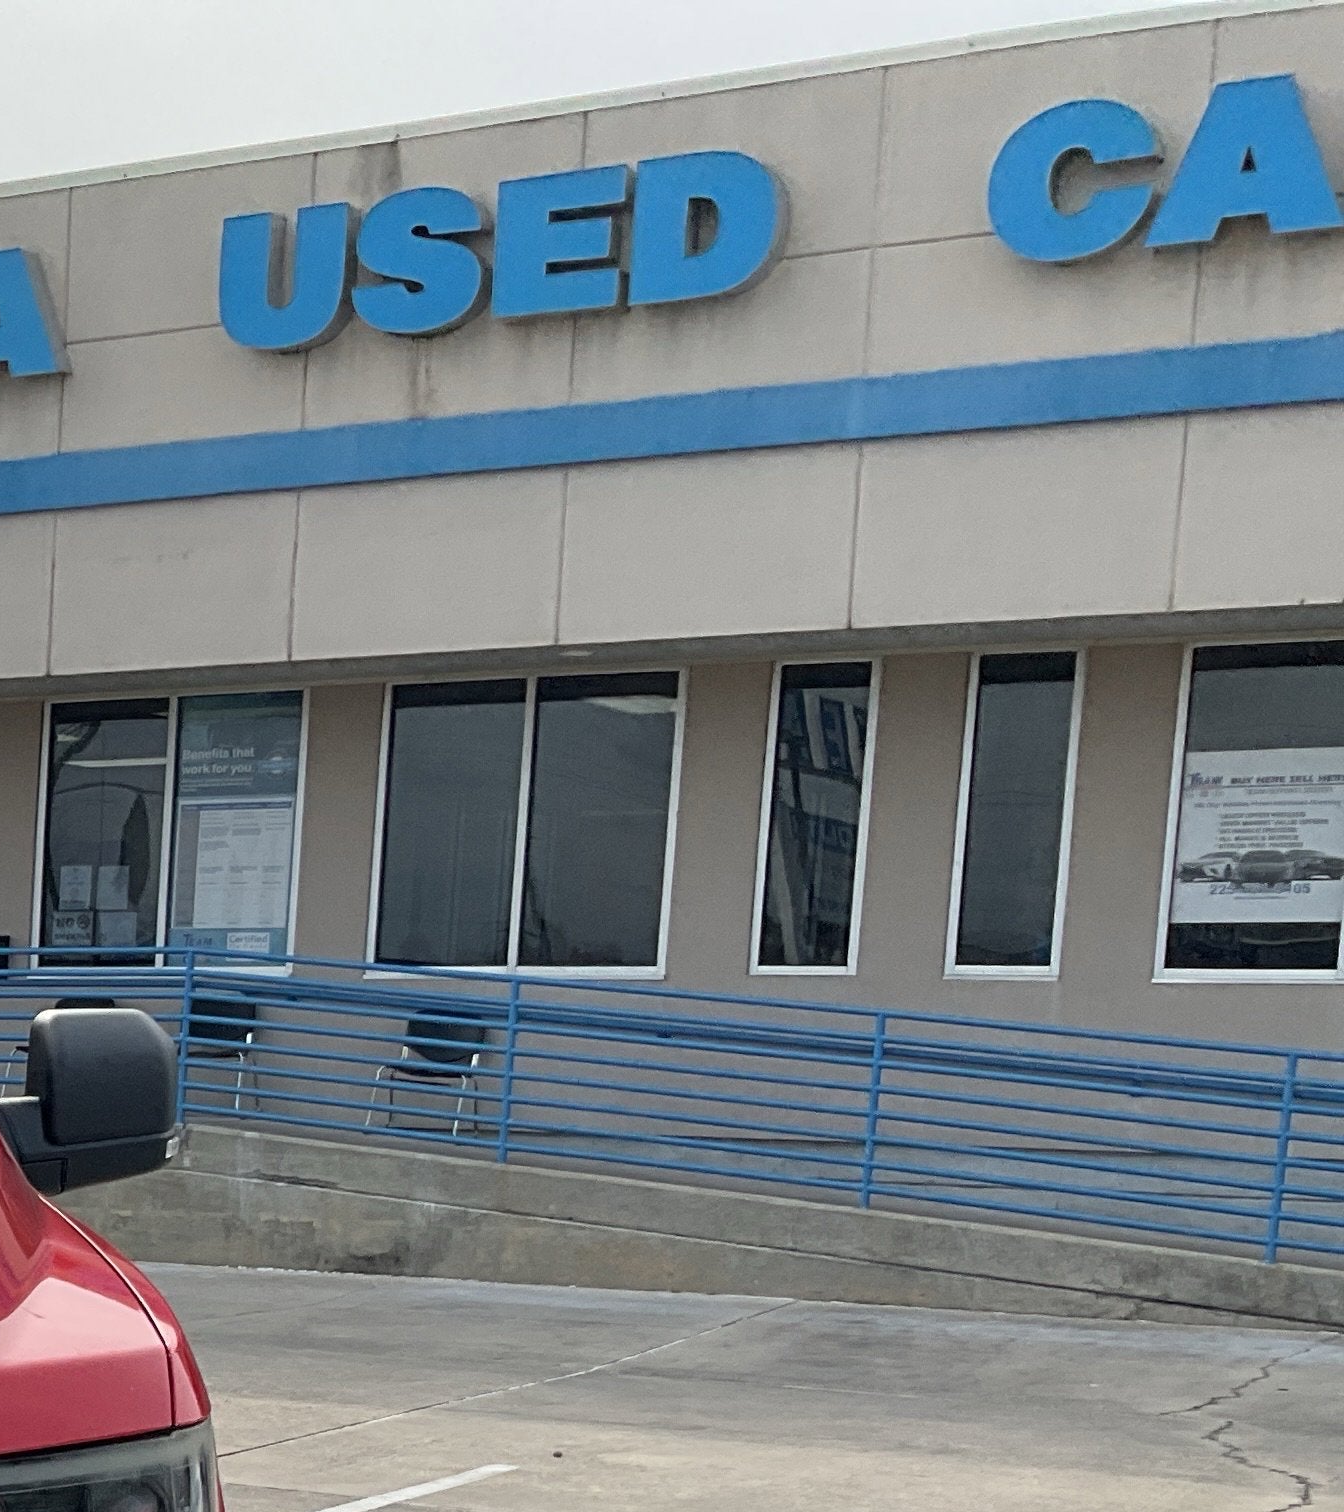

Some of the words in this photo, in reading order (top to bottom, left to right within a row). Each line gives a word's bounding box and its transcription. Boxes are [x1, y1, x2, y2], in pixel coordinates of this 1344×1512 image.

[218, 150, 786, 352] USED
[987, 73, 1344, 264] CA
[182, 747, 229, 760] Benefits
[232, 747, 255, 759] that
[182, 764, 210, 775] work
[212, 763, 228, 773] for
[230, 934, 268, 943] Certified
